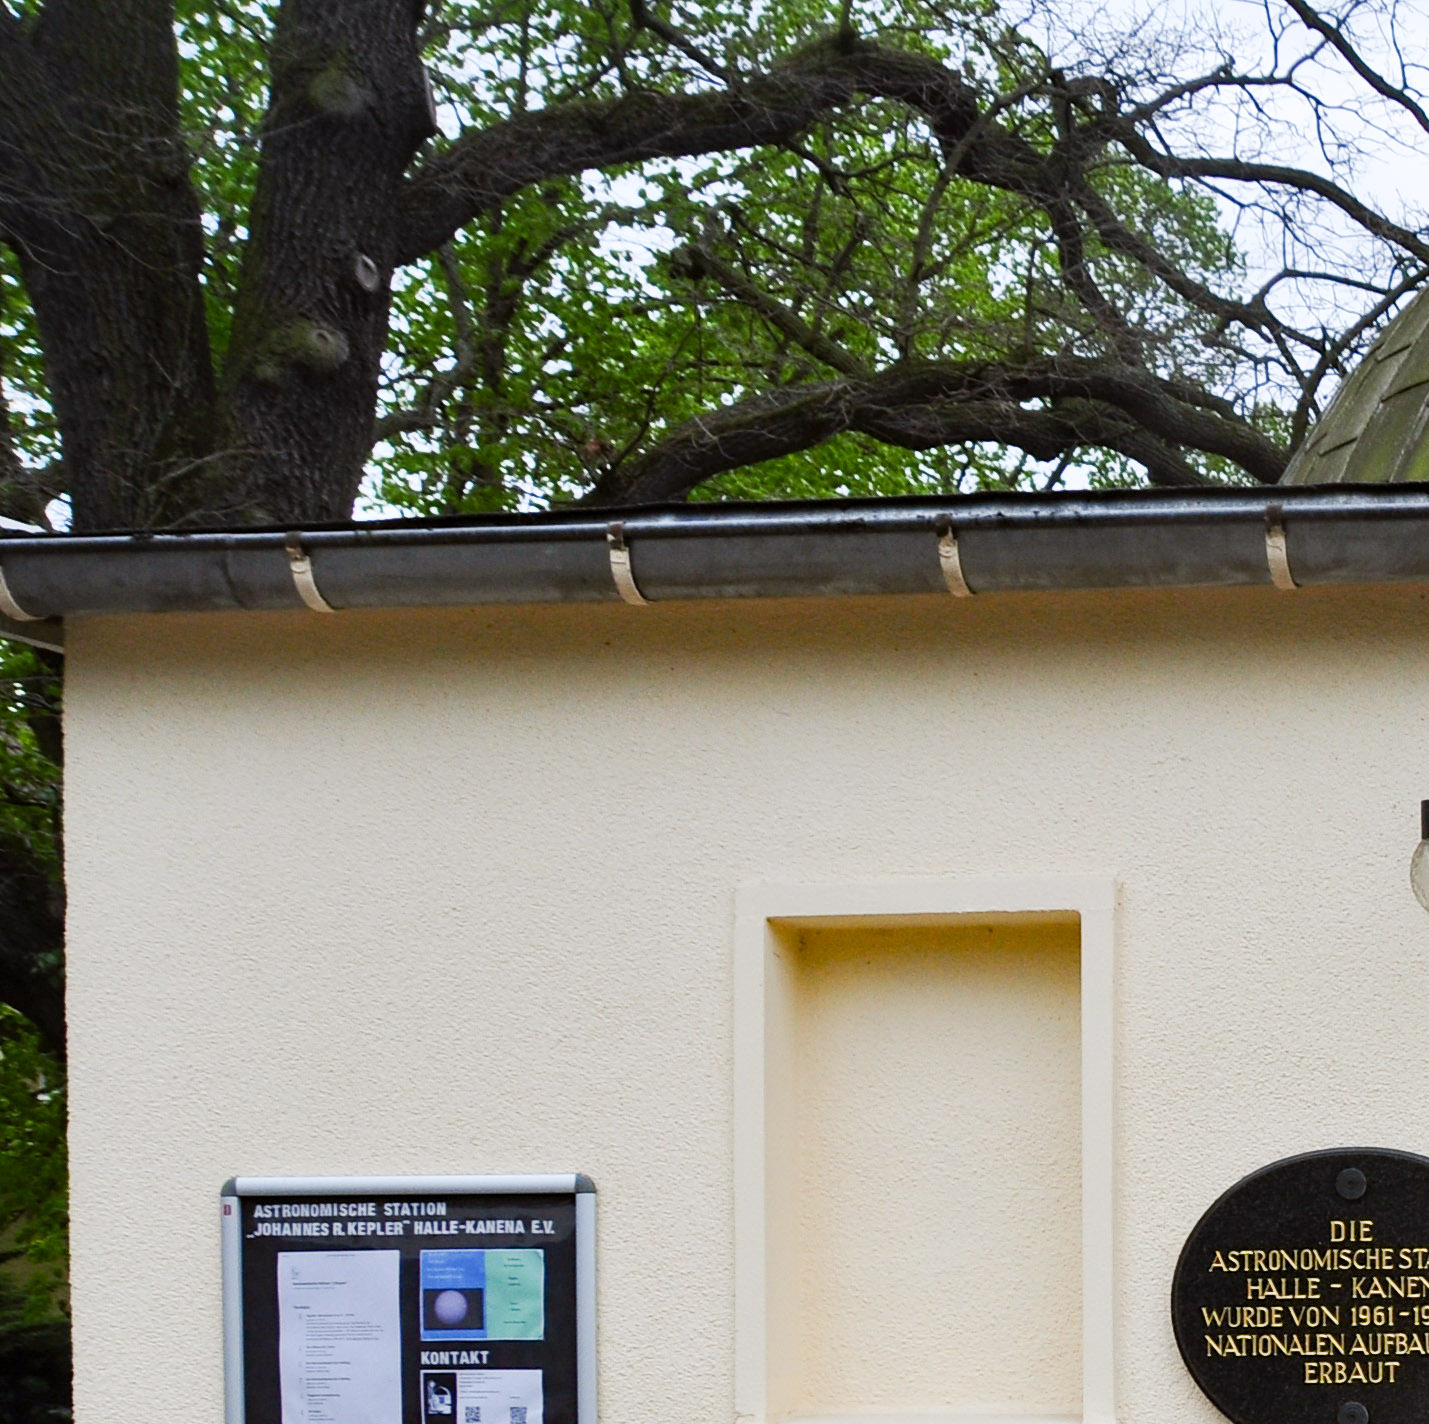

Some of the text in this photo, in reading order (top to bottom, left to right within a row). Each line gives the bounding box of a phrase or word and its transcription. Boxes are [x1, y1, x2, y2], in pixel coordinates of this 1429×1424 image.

[253, 1202, 447, 1218] ASTRONOMISCHE STATION
[414, 1220, 526, 1235] HALLE-KANENA
[531, 1220, 556, 1235] E.V.
[1330, 1220, 1374, 1242] DIE
[1208, 1248, 1394, 1272] ASTRONOMISCHE
[1247, 1277, 1321, 1300] HALLE
[1201, 1305, 1284, 1328] WURDE
[1288, 1305, 1340, 1328] VON
[1204, 1333, 1345, 1357] NATIONALEN
[420, 1350, 490, 1365] KONTAKT
[1304, 1361, 1401, 1384] ERBAUT
